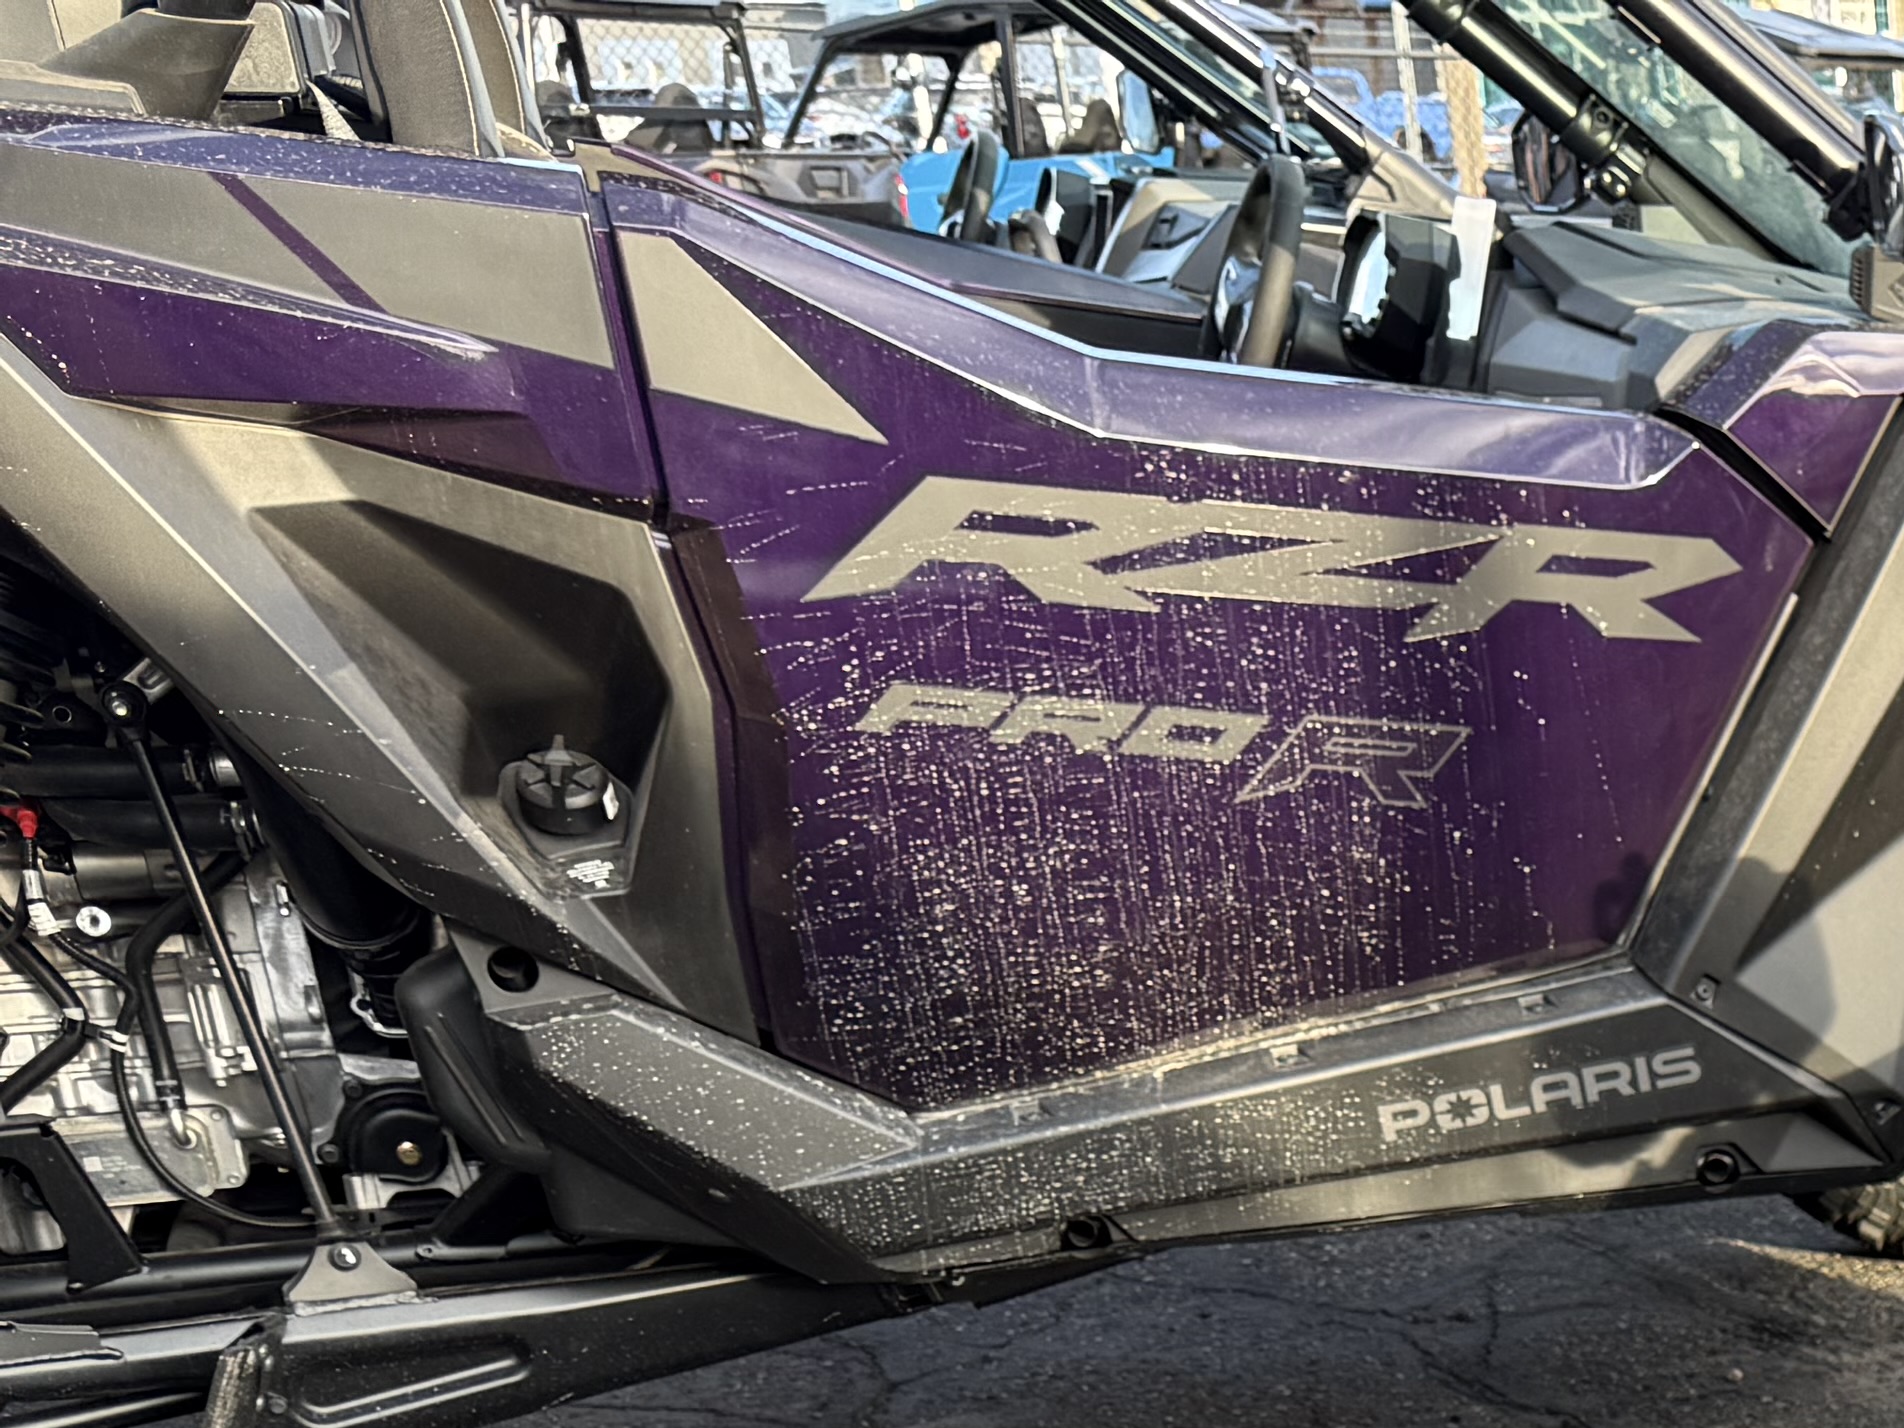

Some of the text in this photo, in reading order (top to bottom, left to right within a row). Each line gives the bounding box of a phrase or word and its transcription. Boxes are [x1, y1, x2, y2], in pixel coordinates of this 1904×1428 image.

[801, 476, 1742, 643] RZR
[855, 682, 1472, 809] PRO R
[1376, 1044, 1702, 1145] POLARIS
